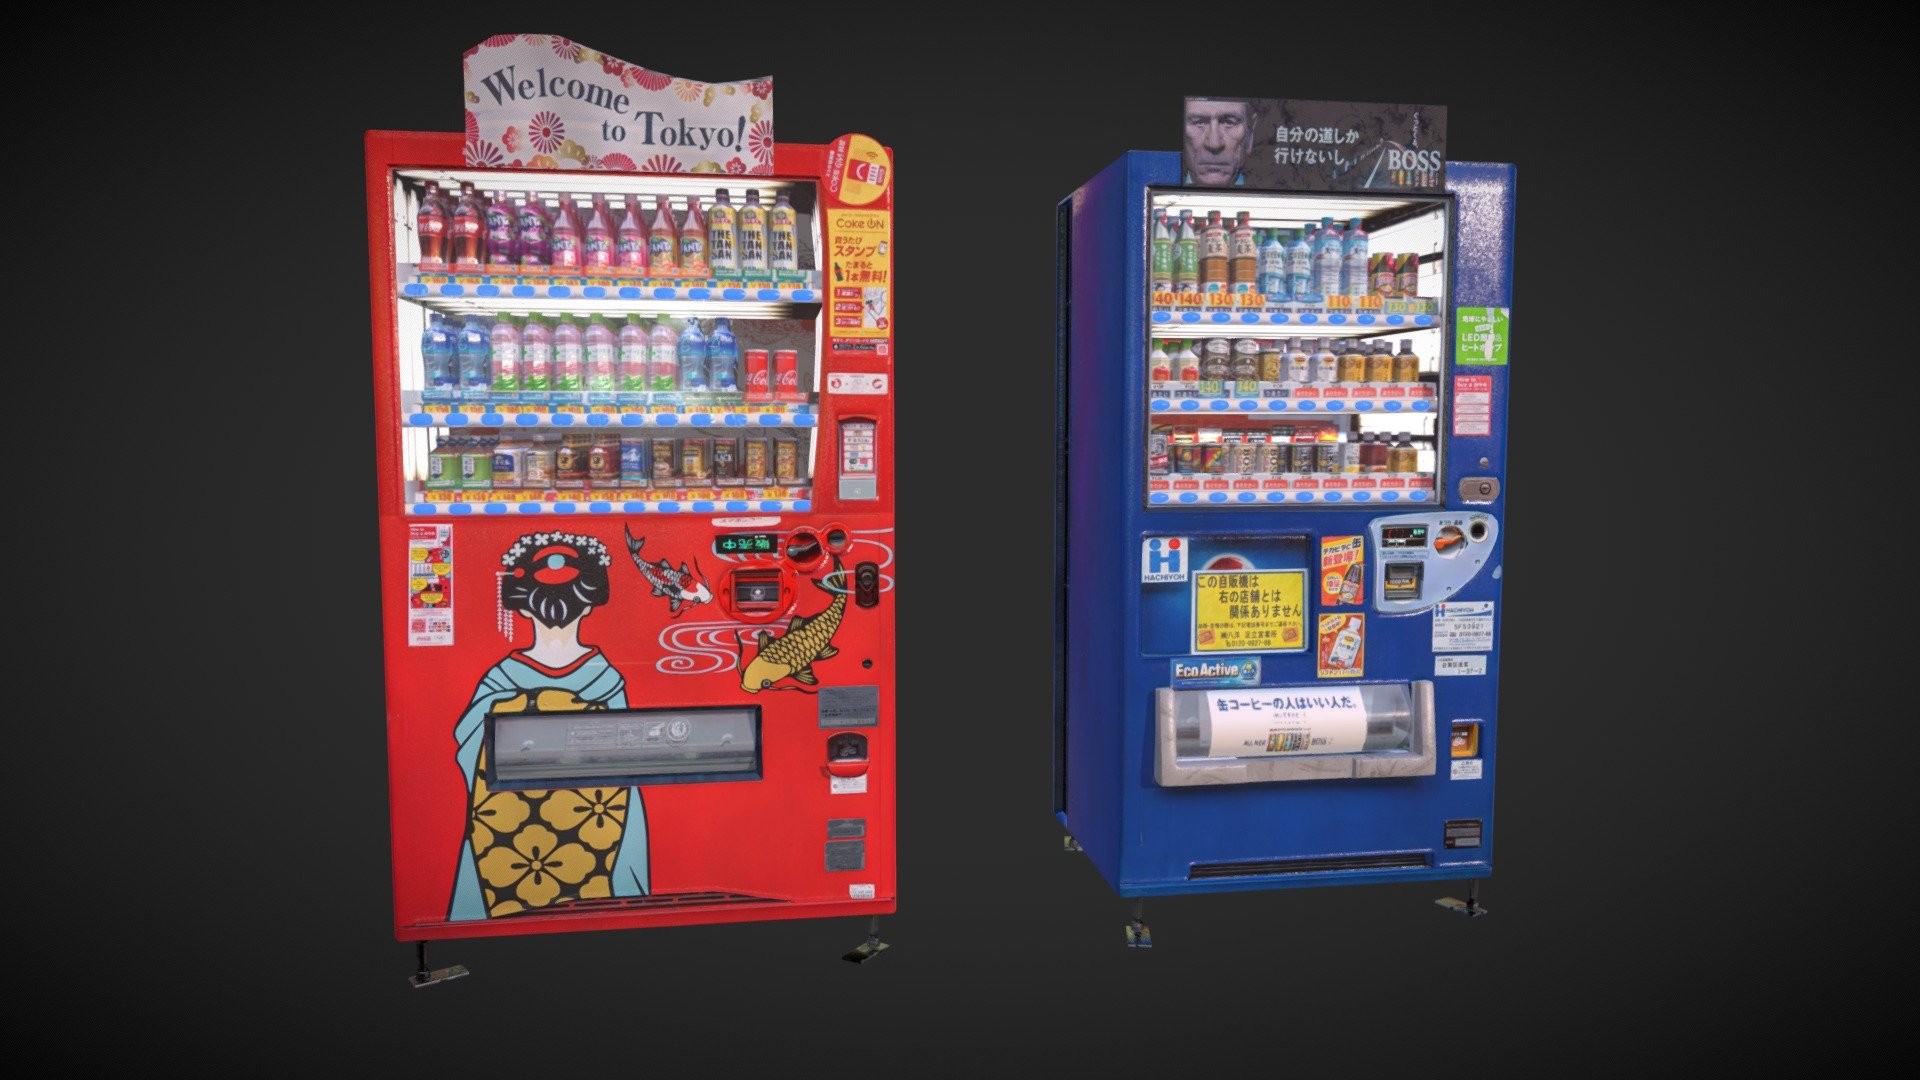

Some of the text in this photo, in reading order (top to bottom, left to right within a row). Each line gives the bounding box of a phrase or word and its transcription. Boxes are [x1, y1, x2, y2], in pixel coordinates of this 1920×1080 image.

[480, 63, 630, 115] Welcome
[601, 110, 748, 153] to Tokyo!
[1275, 125, 1360, 145] 自分の道しか
[1388, 149, 1441, 171] BOSS
[836, 218, 865, 229] Coke
[711, 230, 731, 240] THE
[742, 231, 762, 241] THE
[772, 231, 792, 241] THE
[711, 240, 731, 250] TAN
[742, 241, 762, 251] TAN
[772, 241, 792, 251] TAN
[834, 245, 877, 258] スタンプ
[845, 261, 873, 270] たまると
[1179, 293, 1203, 306] 140
[1208, 294, 1234, 306] 130
[1239, 294, 1265, 306] 130
[1327, 295, 1353, 309] 110
[1359, 295, 1383, 309] 110
[1200, 380, 1219, 393] 140
[1238, 380, 1257, 393] 140
[1198, 575, 1260, 588] この自販機は
[1218, 590, 1282, 604] 右の店舗とは
[1229, 604, 1302, 619] 関係ありません
[1176, 662, 1240, 678] Eco Active
[1216, 695, 1357, 712] 缶コーヒーの人はいい人だ。
